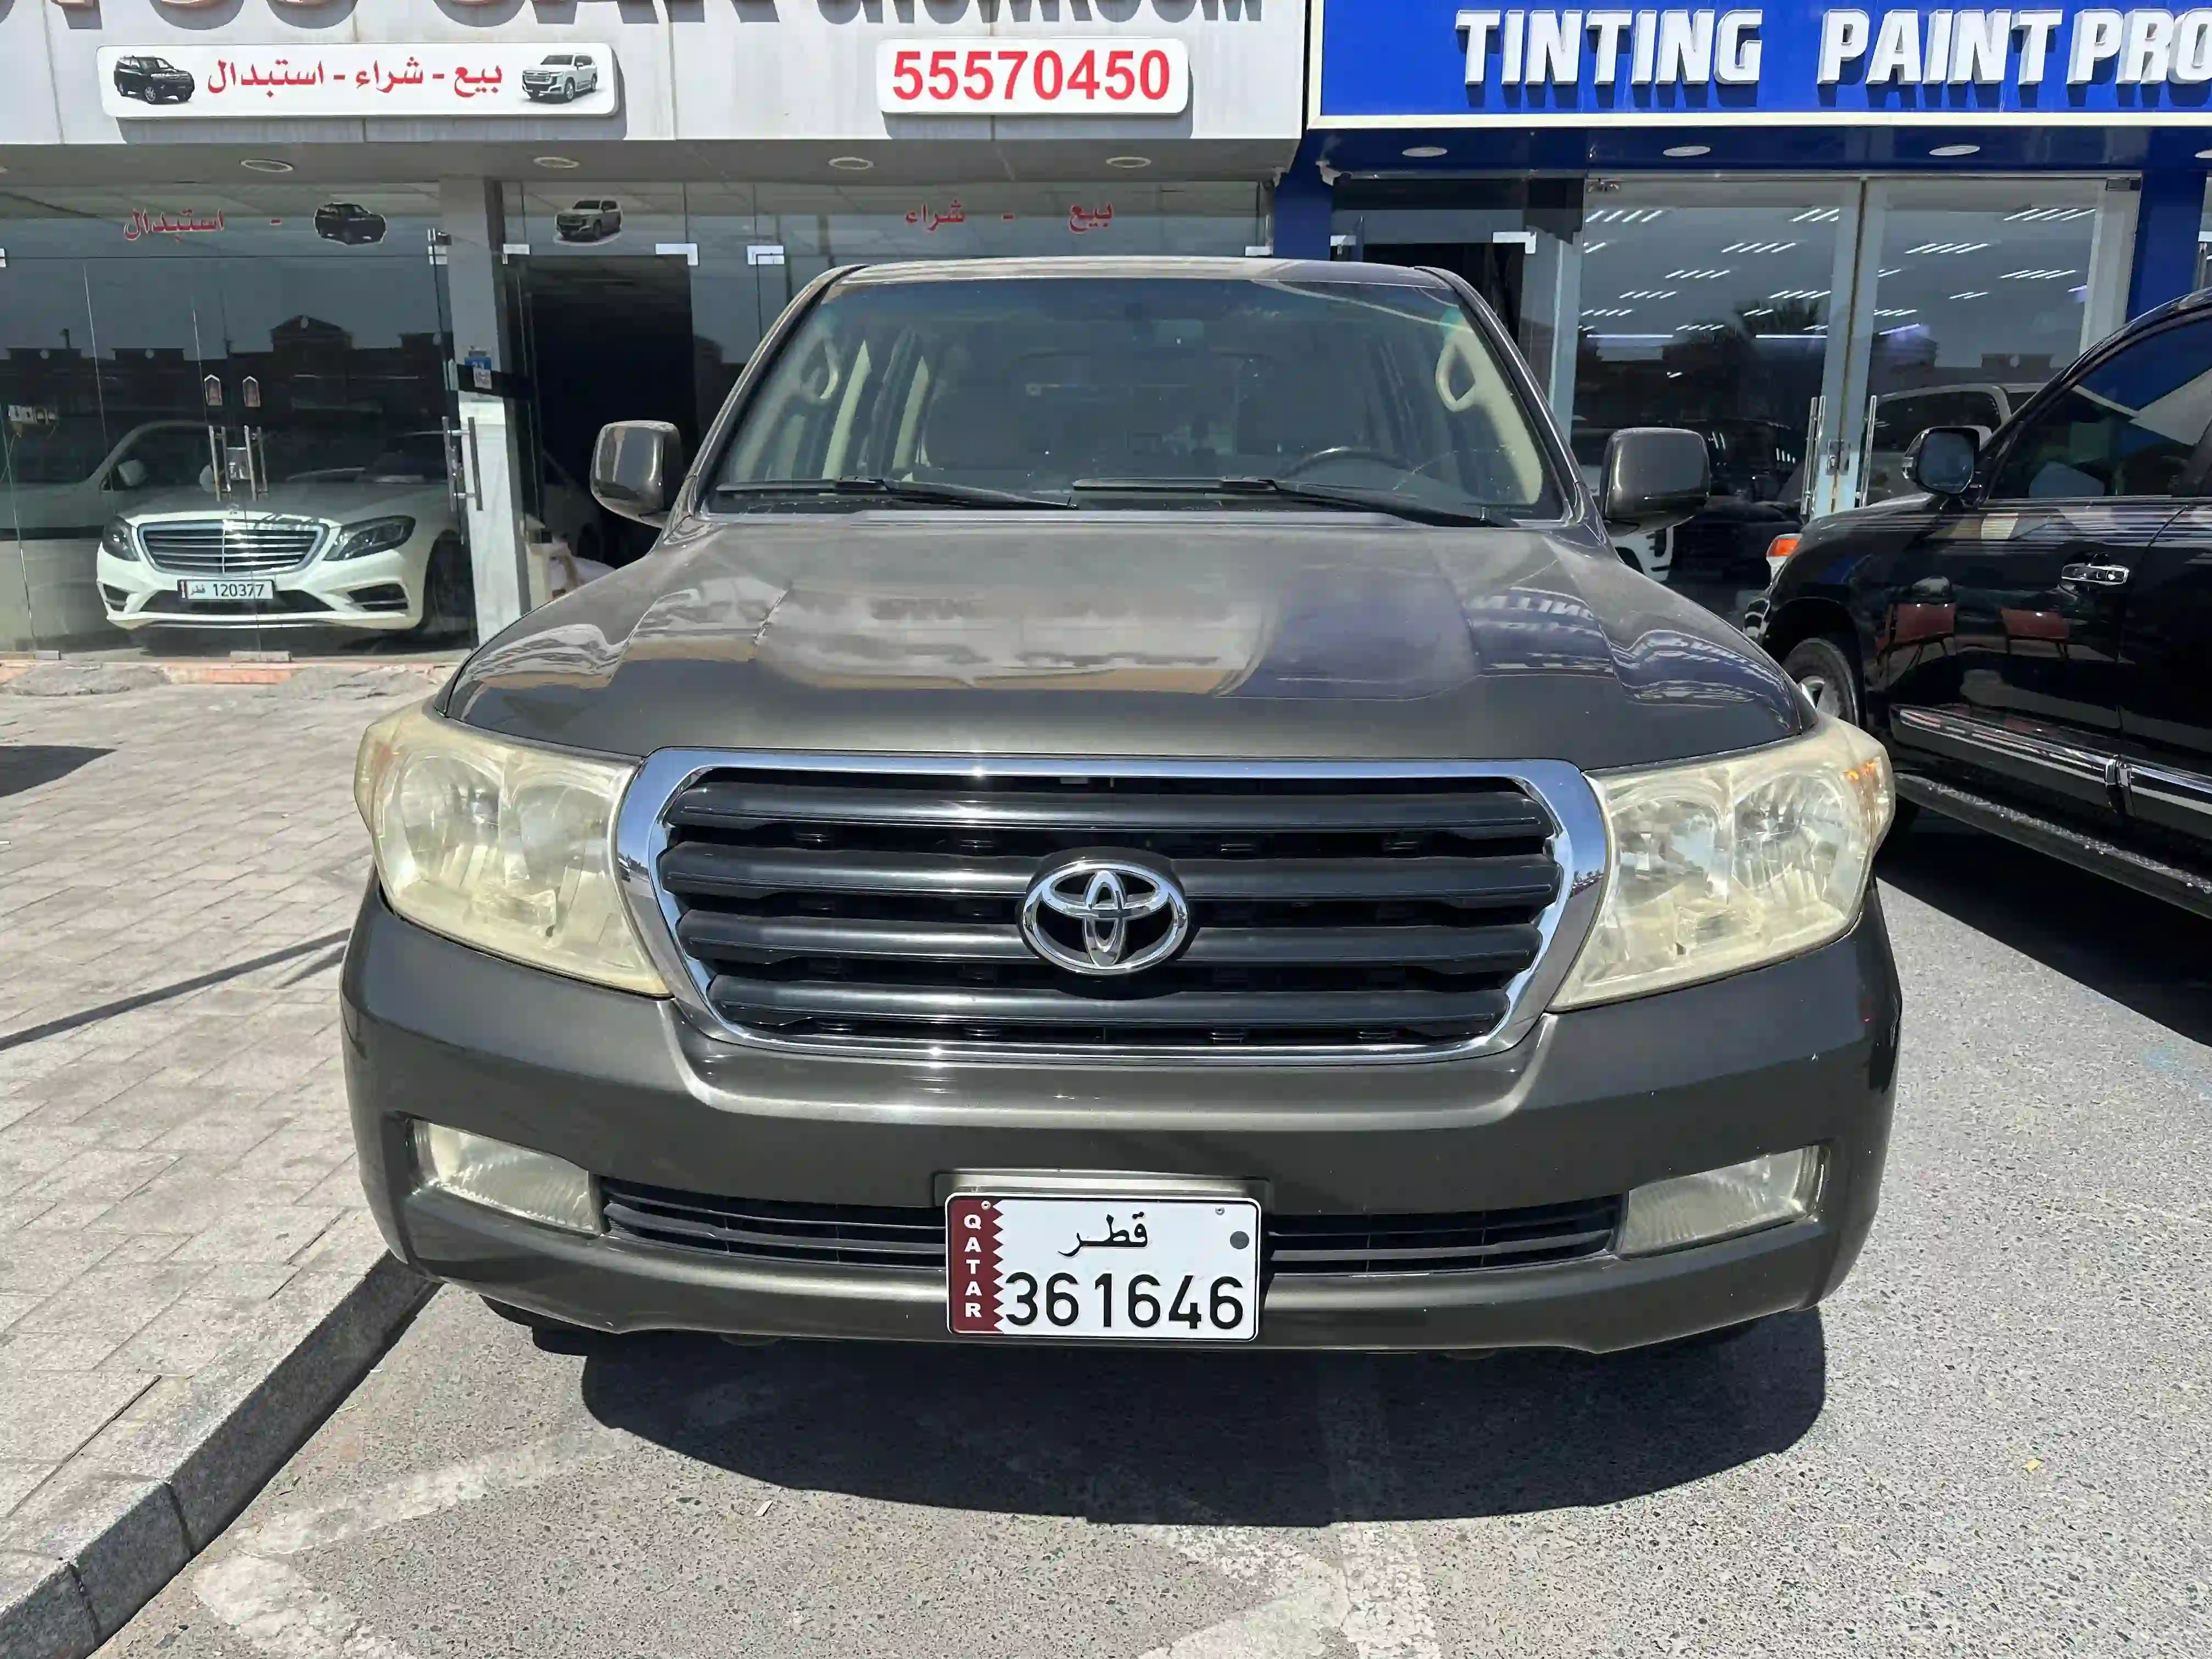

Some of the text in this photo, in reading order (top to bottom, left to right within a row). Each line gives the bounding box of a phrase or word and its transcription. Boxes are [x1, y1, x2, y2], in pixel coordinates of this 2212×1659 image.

[1455, 9, 1763, 84] TINTING
[1816, 9, 2063, 84] PAINT
[208, 59, 324, 97] استبدال
[355, 57, 424, 93] شراء
[454, 65, 502, 98] بيع
[893, 49, 1170, 100] 55570450
[124, 208, 224, 242] استبدال
[905, 199, 965, 232] شراء
[1069, 203, 1113, 233] بيع
[213, 584, 264, 597] 120377
[1058, 1211, 1148, 1258] قطر
[963, 1214, 982, 1318] QATAR
[1005, 1272, 1244, 1330] 361646
